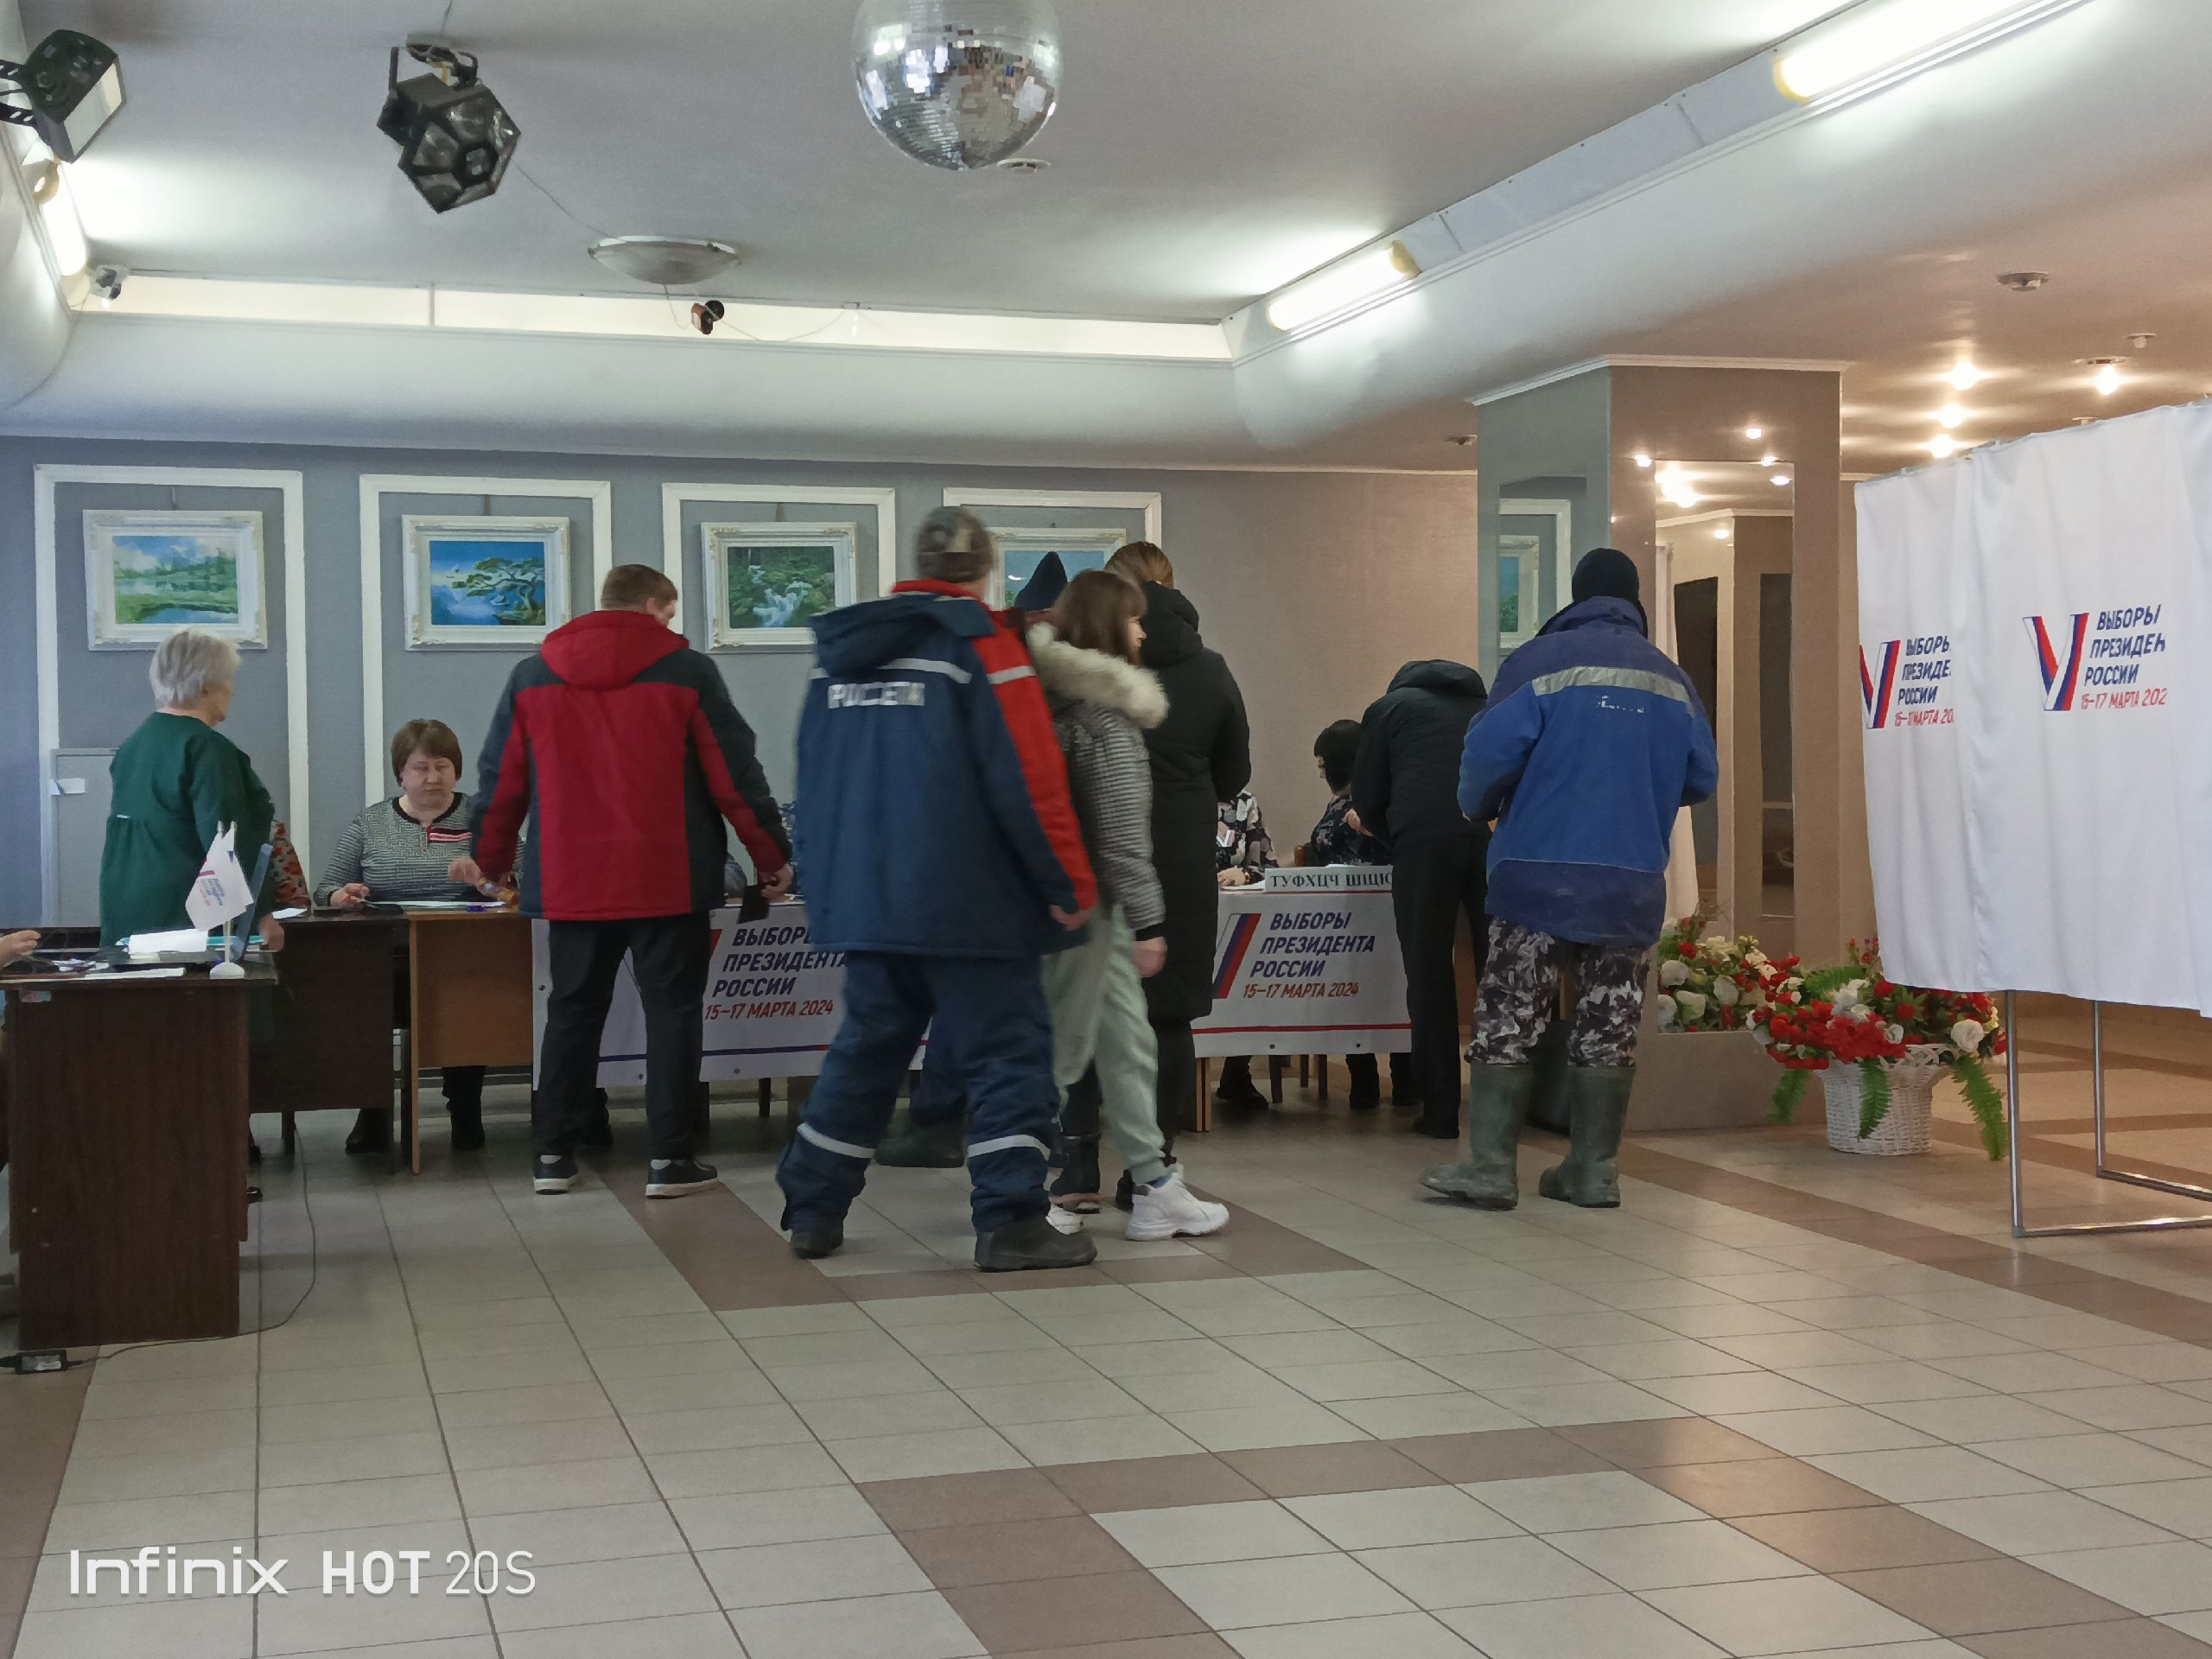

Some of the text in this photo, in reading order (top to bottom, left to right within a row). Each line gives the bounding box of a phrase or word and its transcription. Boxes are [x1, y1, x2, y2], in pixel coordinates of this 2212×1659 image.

[2096, 604, 2161, 630] ВЫБОРЫ
[2089, 632, 2166, 658] ПРЕЗИДЕН
[1902, 659, 1951, 681] ПРЕЗИДЕ
[2084, 664, 2139, 686] РОССИИ
[2109, 690, 2140, 709] МАРТА
[2142, 688, 2168, 707] 202
[1940, 709, 1955, 724] 20
[1270, 874, 1339, 888] ТУФХЦЧ
[1270, 912, 1352, 931] ВЫБОРЫ
[1260, 936, 1376, 956] ПРЕЗИДЕНТА
[722, 951, 849, 973] ПРЕЗИДЕНТА
[1250, 960, 1326, 977] РОССИИ
[712, 977, 797, 998] РОССИИ
[1281, 982, 1325, 998] МАРТА
[1327, 982, 1359, 997] 2024
[747, 1001, 797, 1019] МАРТА
[799, 1000, 833, 1016] 2024
